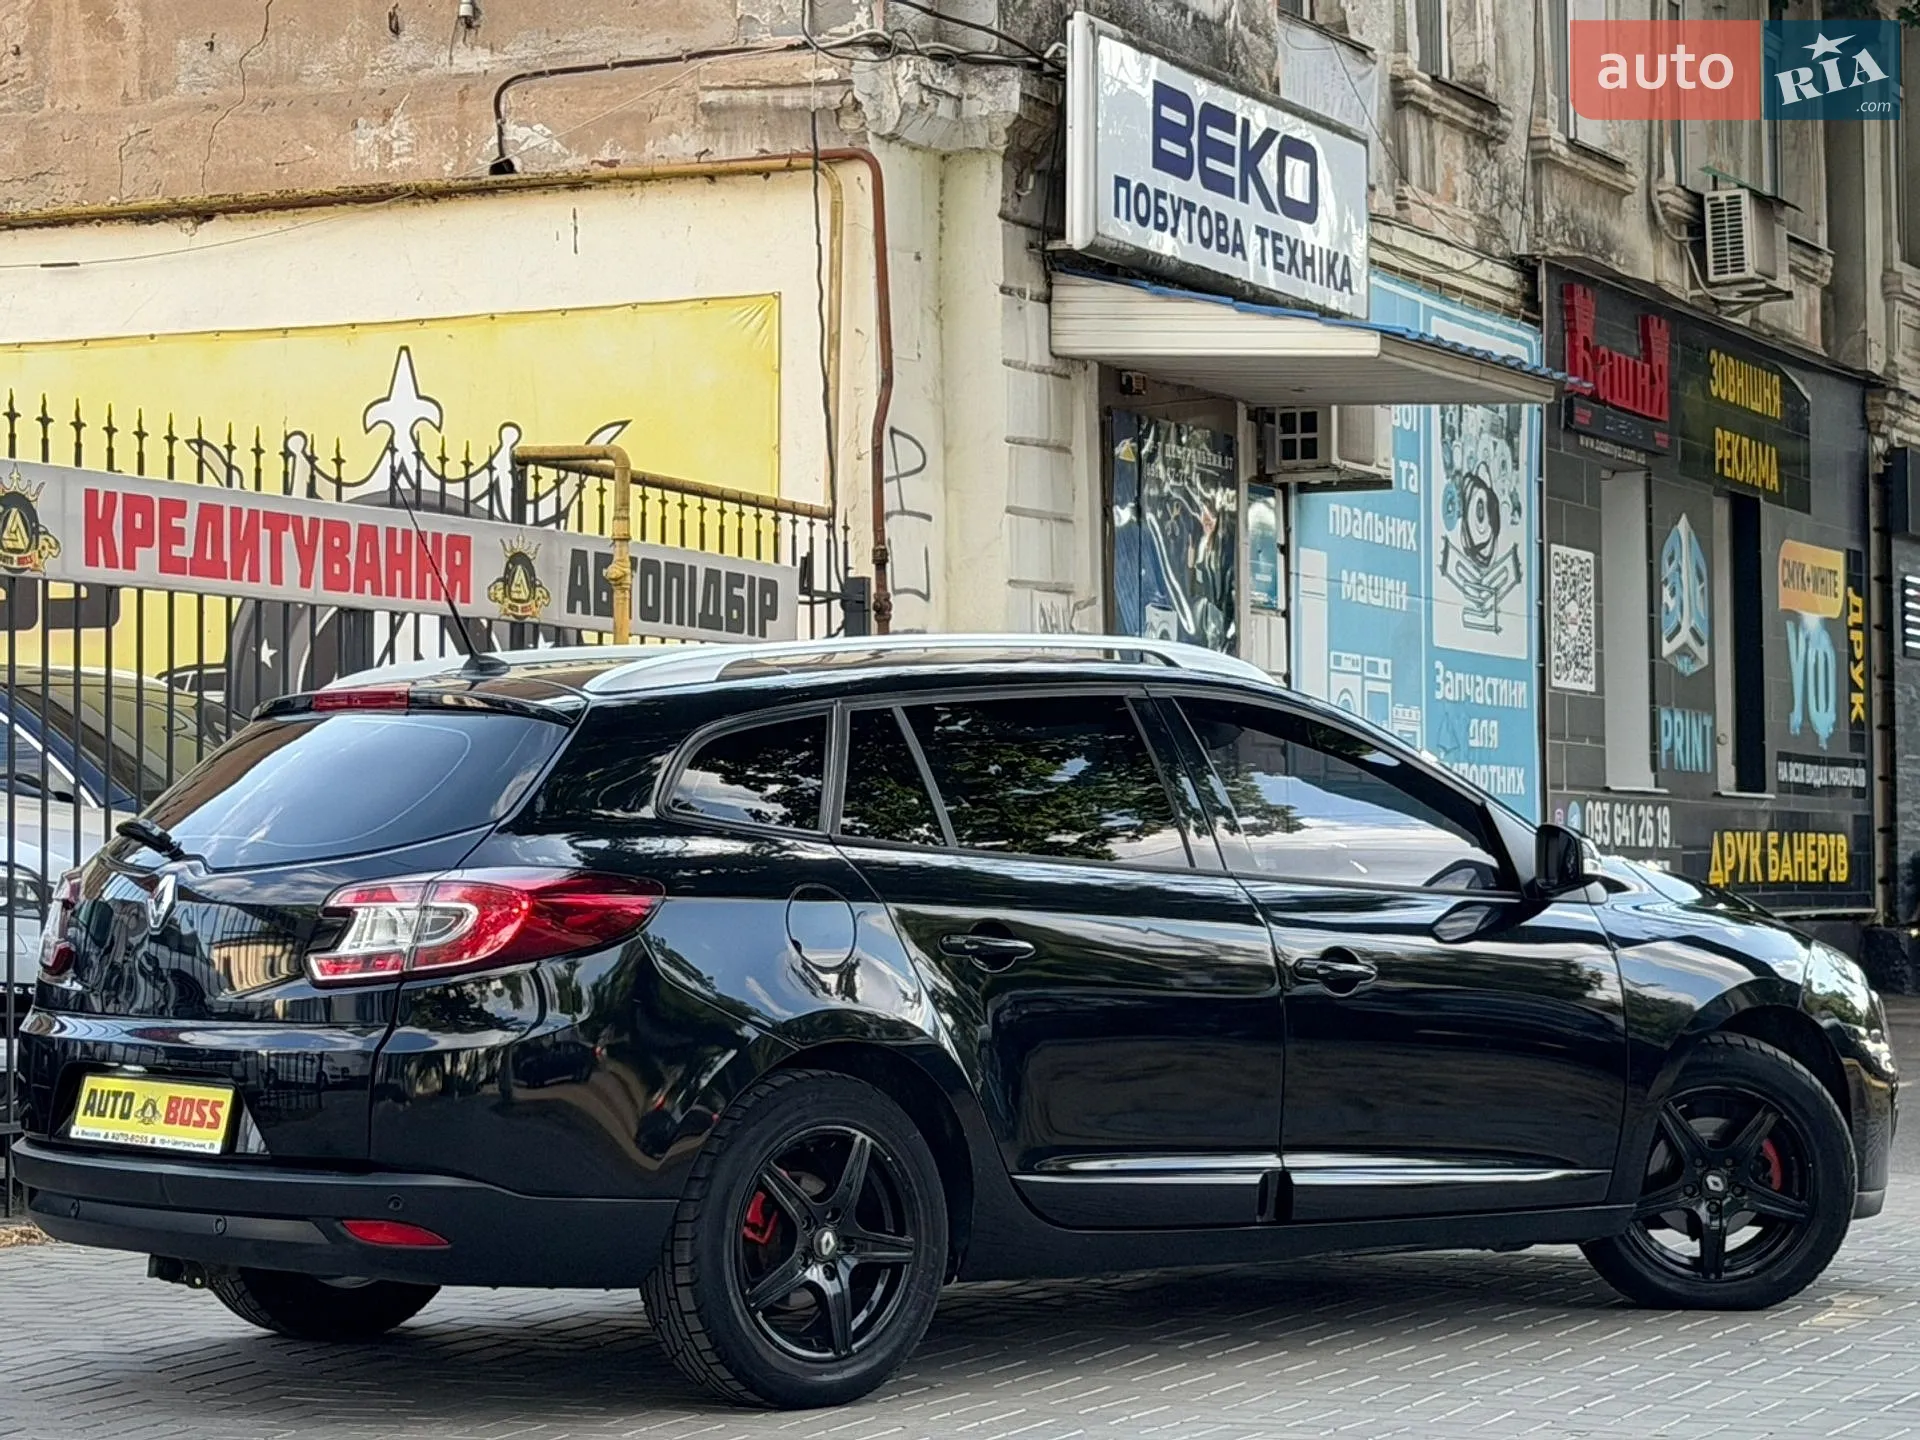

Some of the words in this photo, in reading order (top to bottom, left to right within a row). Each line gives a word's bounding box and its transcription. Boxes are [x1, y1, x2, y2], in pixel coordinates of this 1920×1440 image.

[1152, 79, 1319, 225] BEKO
[1113, 175, 1247, 262] ПОБУТОВА
[1255, 224, 1354, 296] ТЕХНІКА
[1709, 349, 1781, 420] ЗОВНІШНЯ
[1399, 460, 1419, 493] та
[1714, 427, 1780, 493] РЕКЛАМА
[84, 487, 472, 604] КРЕДИТУВАННЯ
[1328, 503, 1417, 551] пральних
[566, 548, 778, 638] АВОПІДБІР
[1341, 569, 1409, 612] машин
[1434, 660, 1529, 709] Запчастини
[1847, 587, 1865, 723] ДРУК
[1469, 718, 1499, 749] для
[1660, 707, 1713, 773] PRINT
[1585, 800, 1611, 846] 093
[1613, 802, 1636, 847] 641
[1638, 804, 1654, 848] 26
[1656, 806, 1671, 848] 19
[1708, 832, 1763, 888] ДРУК
[1768, 830, 1848, 883] БАНЕРІВ
[82, 1088, 135, 1120] AUTO
[163, 1095, 225, 1130] BOSS
